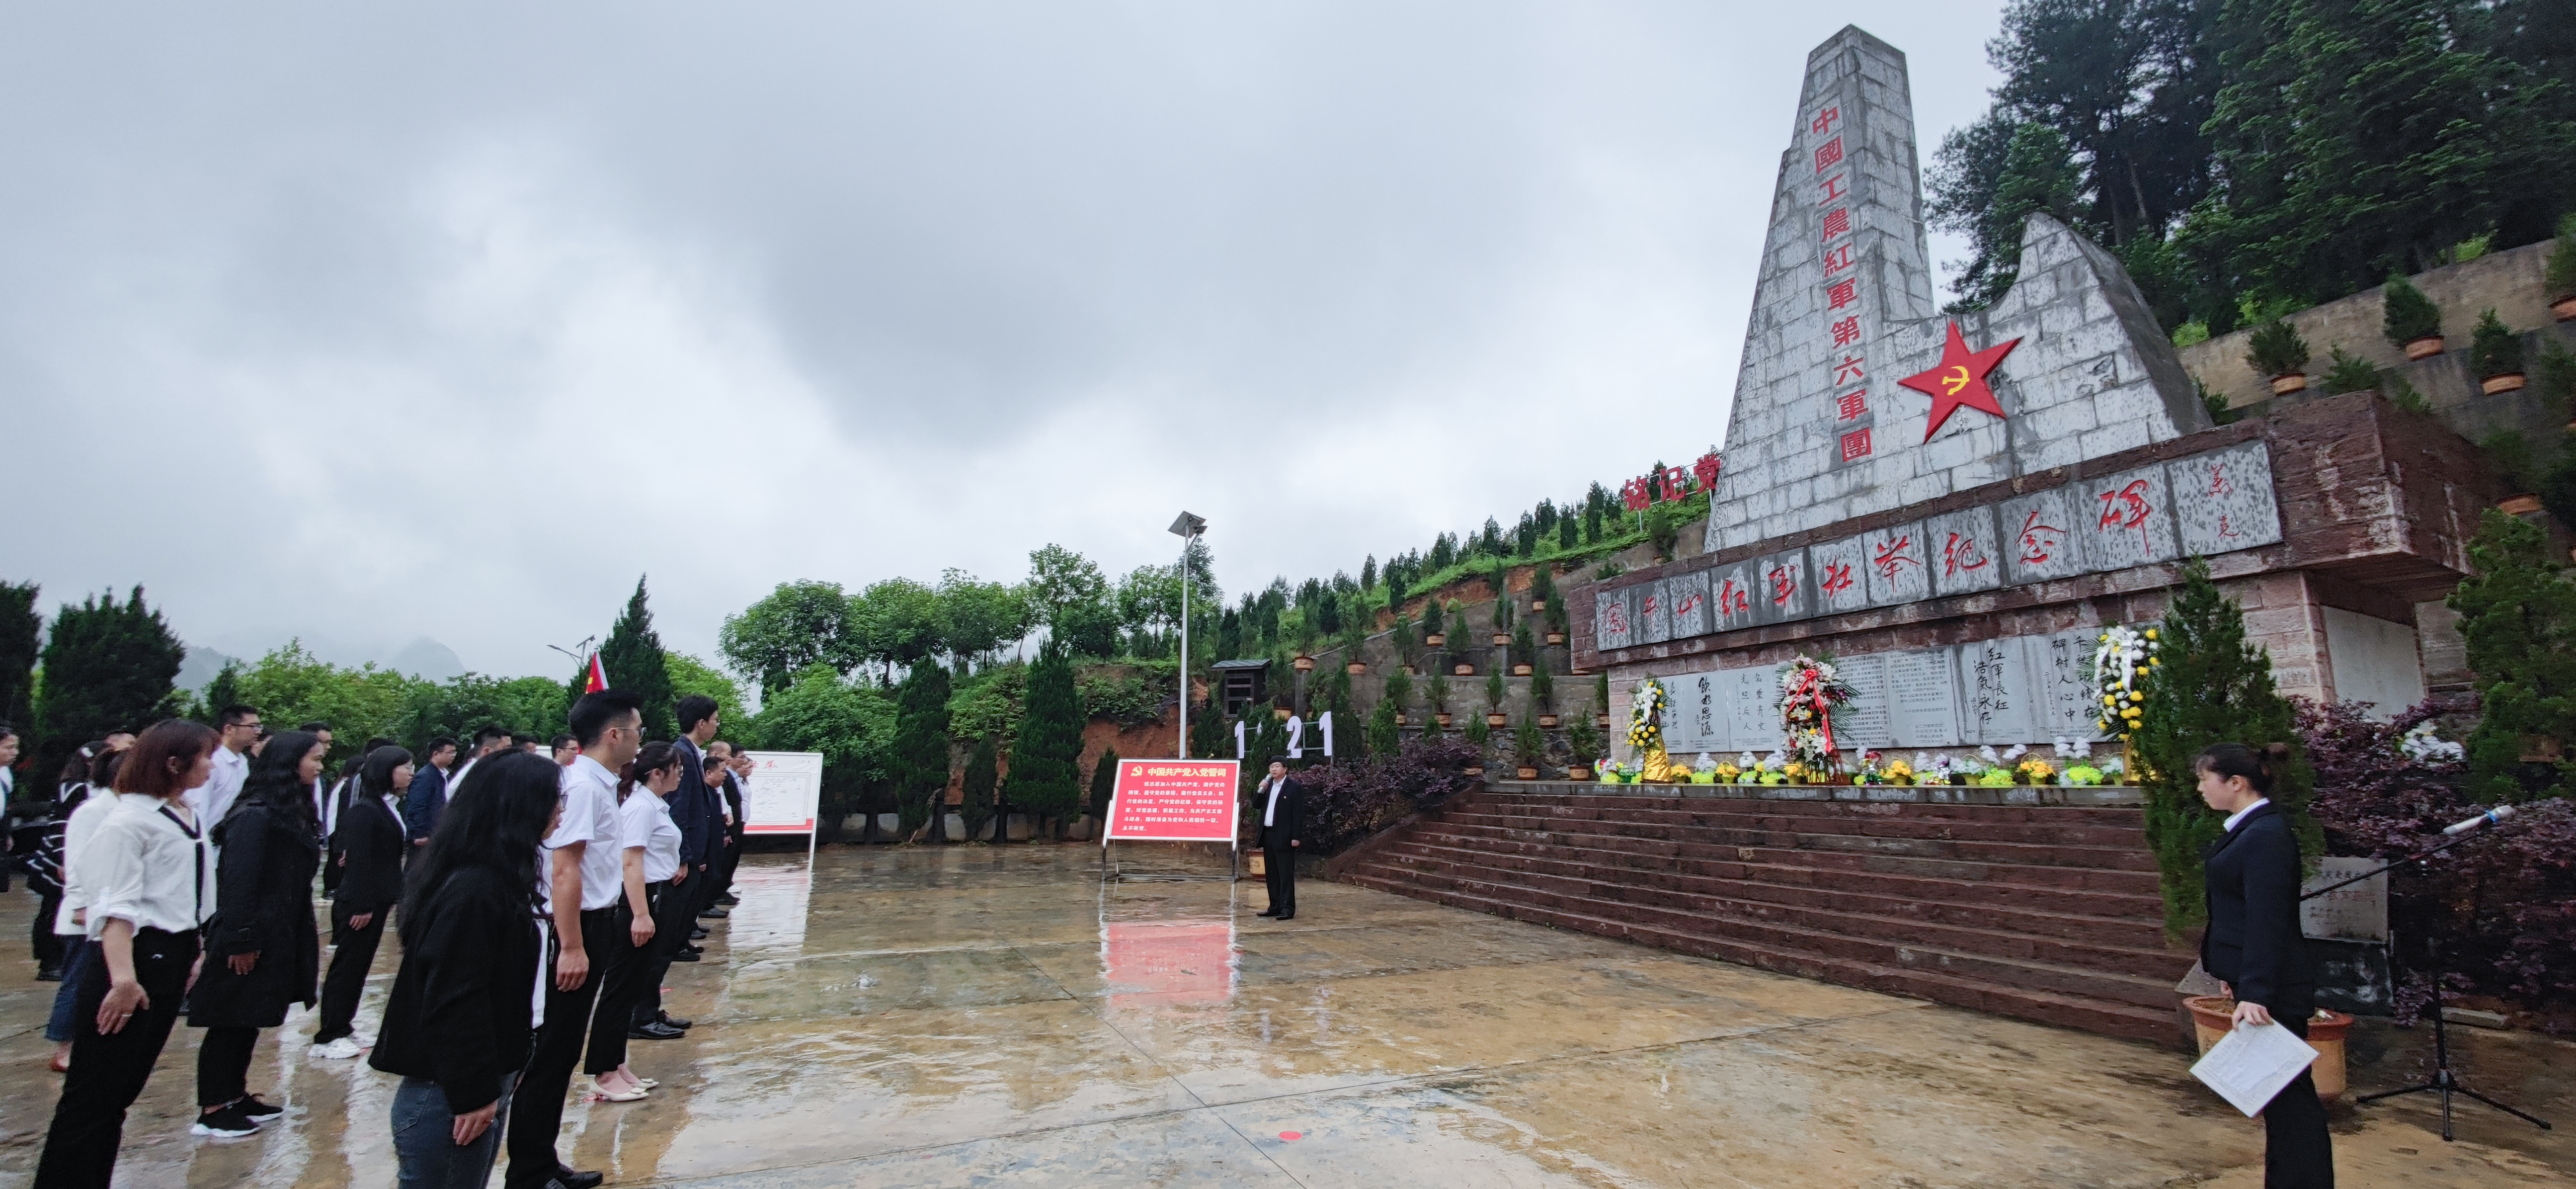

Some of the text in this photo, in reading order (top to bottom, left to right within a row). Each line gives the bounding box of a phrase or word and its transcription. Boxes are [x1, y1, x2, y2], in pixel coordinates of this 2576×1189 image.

[1812, 106, 1872, 463] 中國工農紅軍第六軍團
[1623, 453, 1721, 512] 铭记党
[1741, 673, 1752, 731] 光照后人
[1755, 673, 1766, 731] 名垂青史
[1147, 767, 1226, 777] 中国共产党入党誓词
